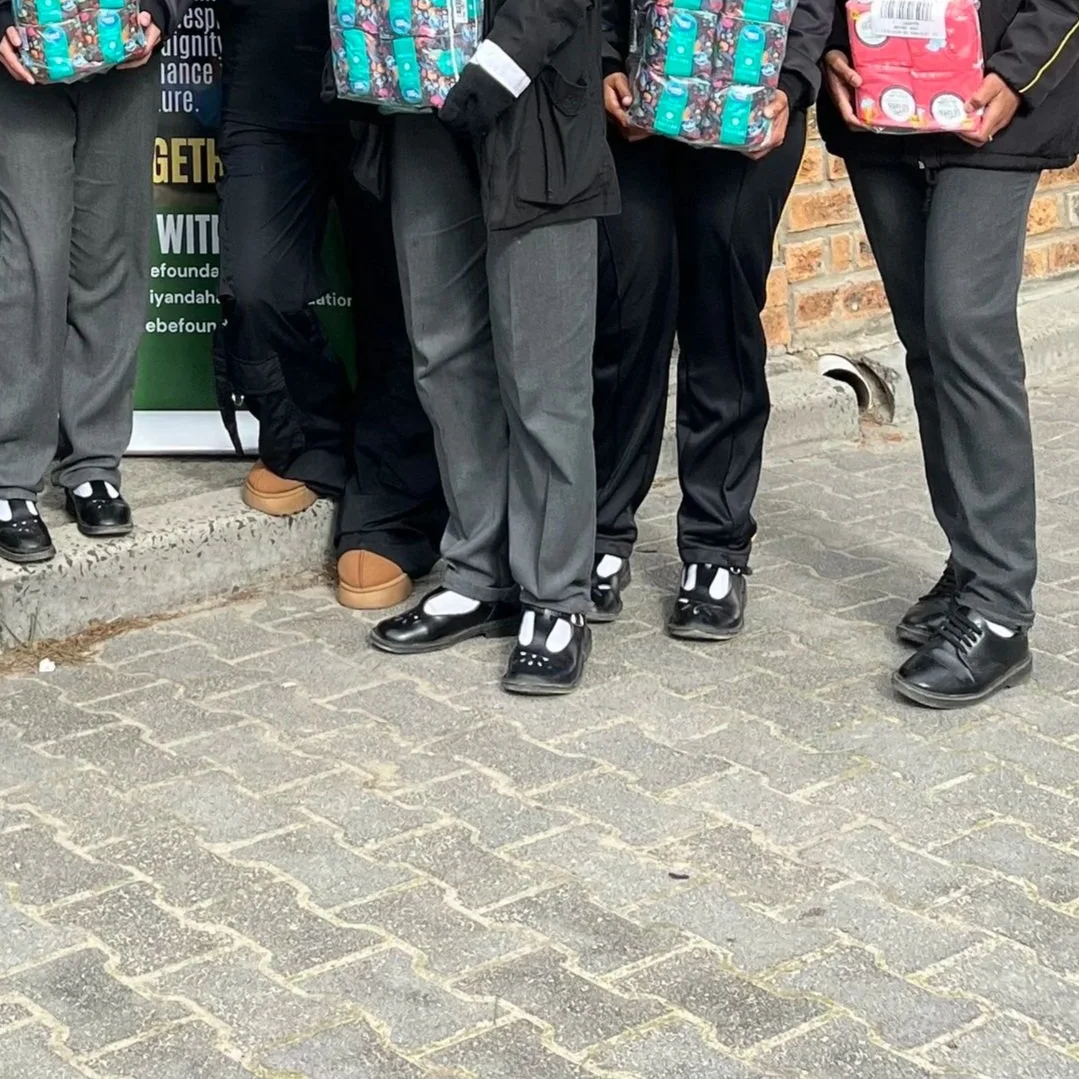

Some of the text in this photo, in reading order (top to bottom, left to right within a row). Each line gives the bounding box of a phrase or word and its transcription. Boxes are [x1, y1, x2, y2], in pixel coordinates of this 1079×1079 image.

[158, 90, 199, 113] ure.
[150, 262, 219, 278] efounda
[149, 289, 221, 307] iyandah
